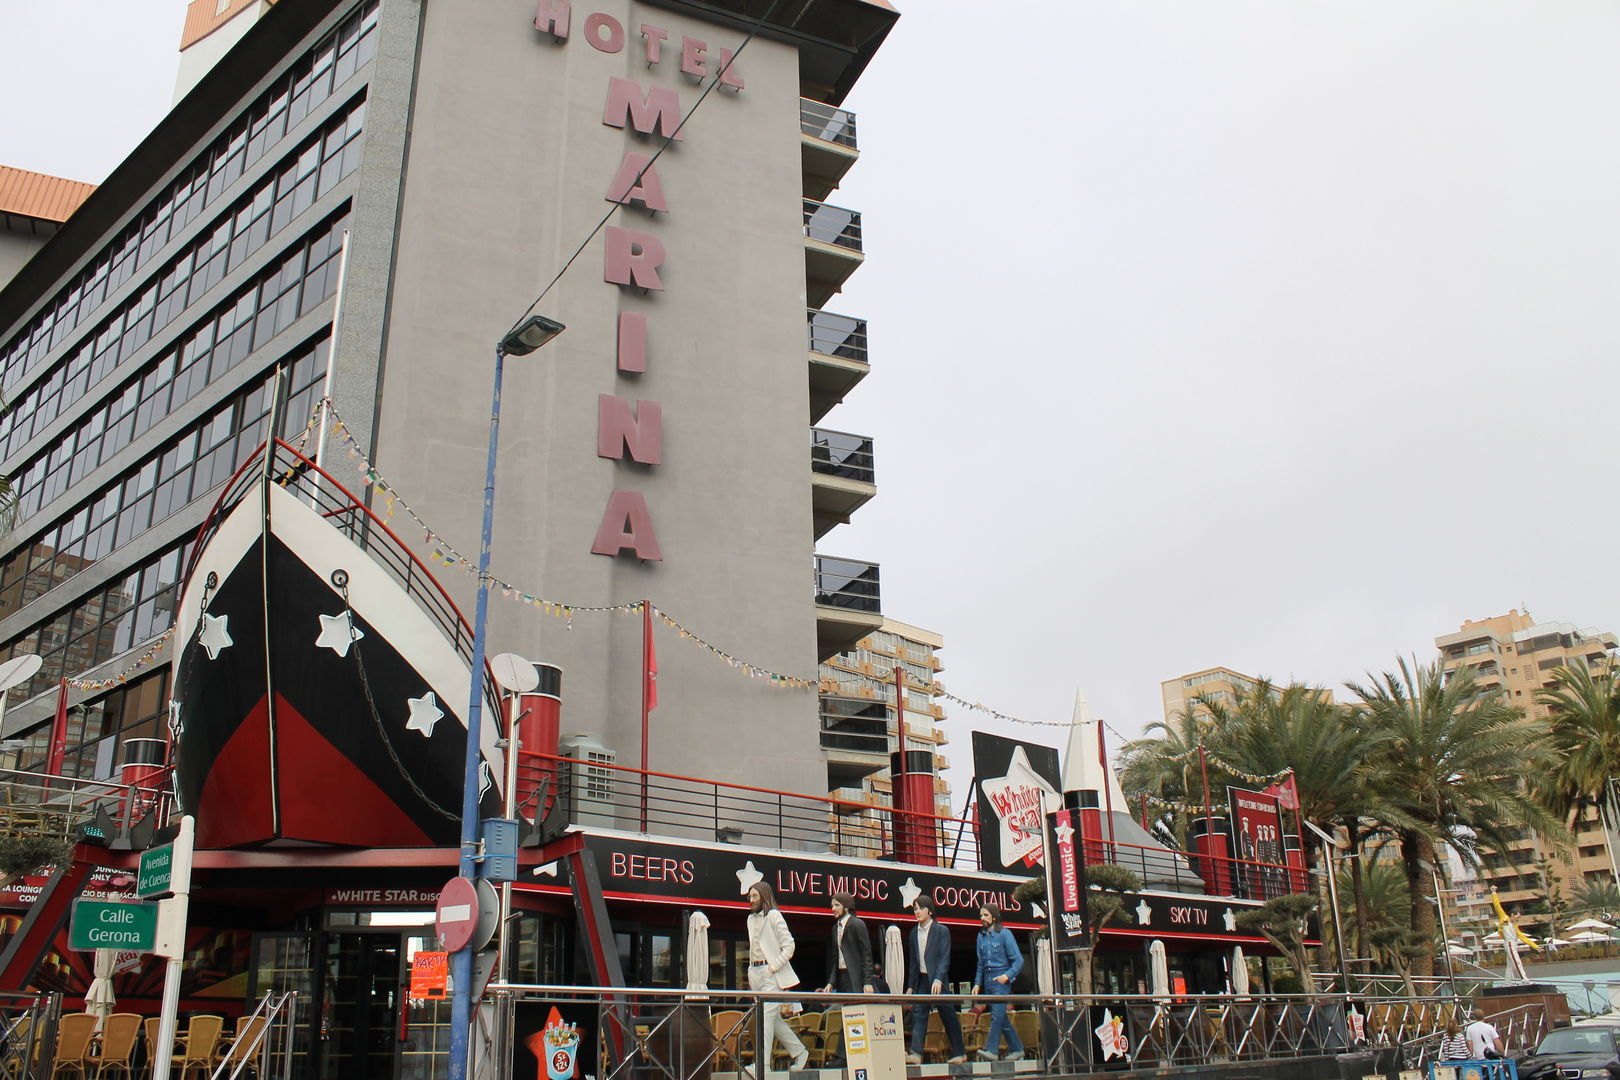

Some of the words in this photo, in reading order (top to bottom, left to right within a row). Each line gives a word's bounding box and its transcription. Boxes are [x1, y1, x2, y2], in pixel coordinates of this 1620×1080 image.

[534, 0, 745, 90] HOTEL
[591, 76, 683, 563] MARINA
[145, 853, 169, 871] Avenida
[611, 852, 695, 884] BEERS
[140, 875, 148, 889] de
[149, 872, 171, 888] Cuenca
[777, 870, 824, 896] LIVE
[827, 875, 889, 901] MUSIC
[337, 890, 381, 901] WHITE
[384, 890, 418, 901] STAR
[933, 886, 1021, 912] COCKTAILS
[100, 909, 134, 924] Calle
[1170, 906, 1191, 924] SKY
[1192, 908, 1208, 925] TV
[88, 928, 141, 943] Gerona
